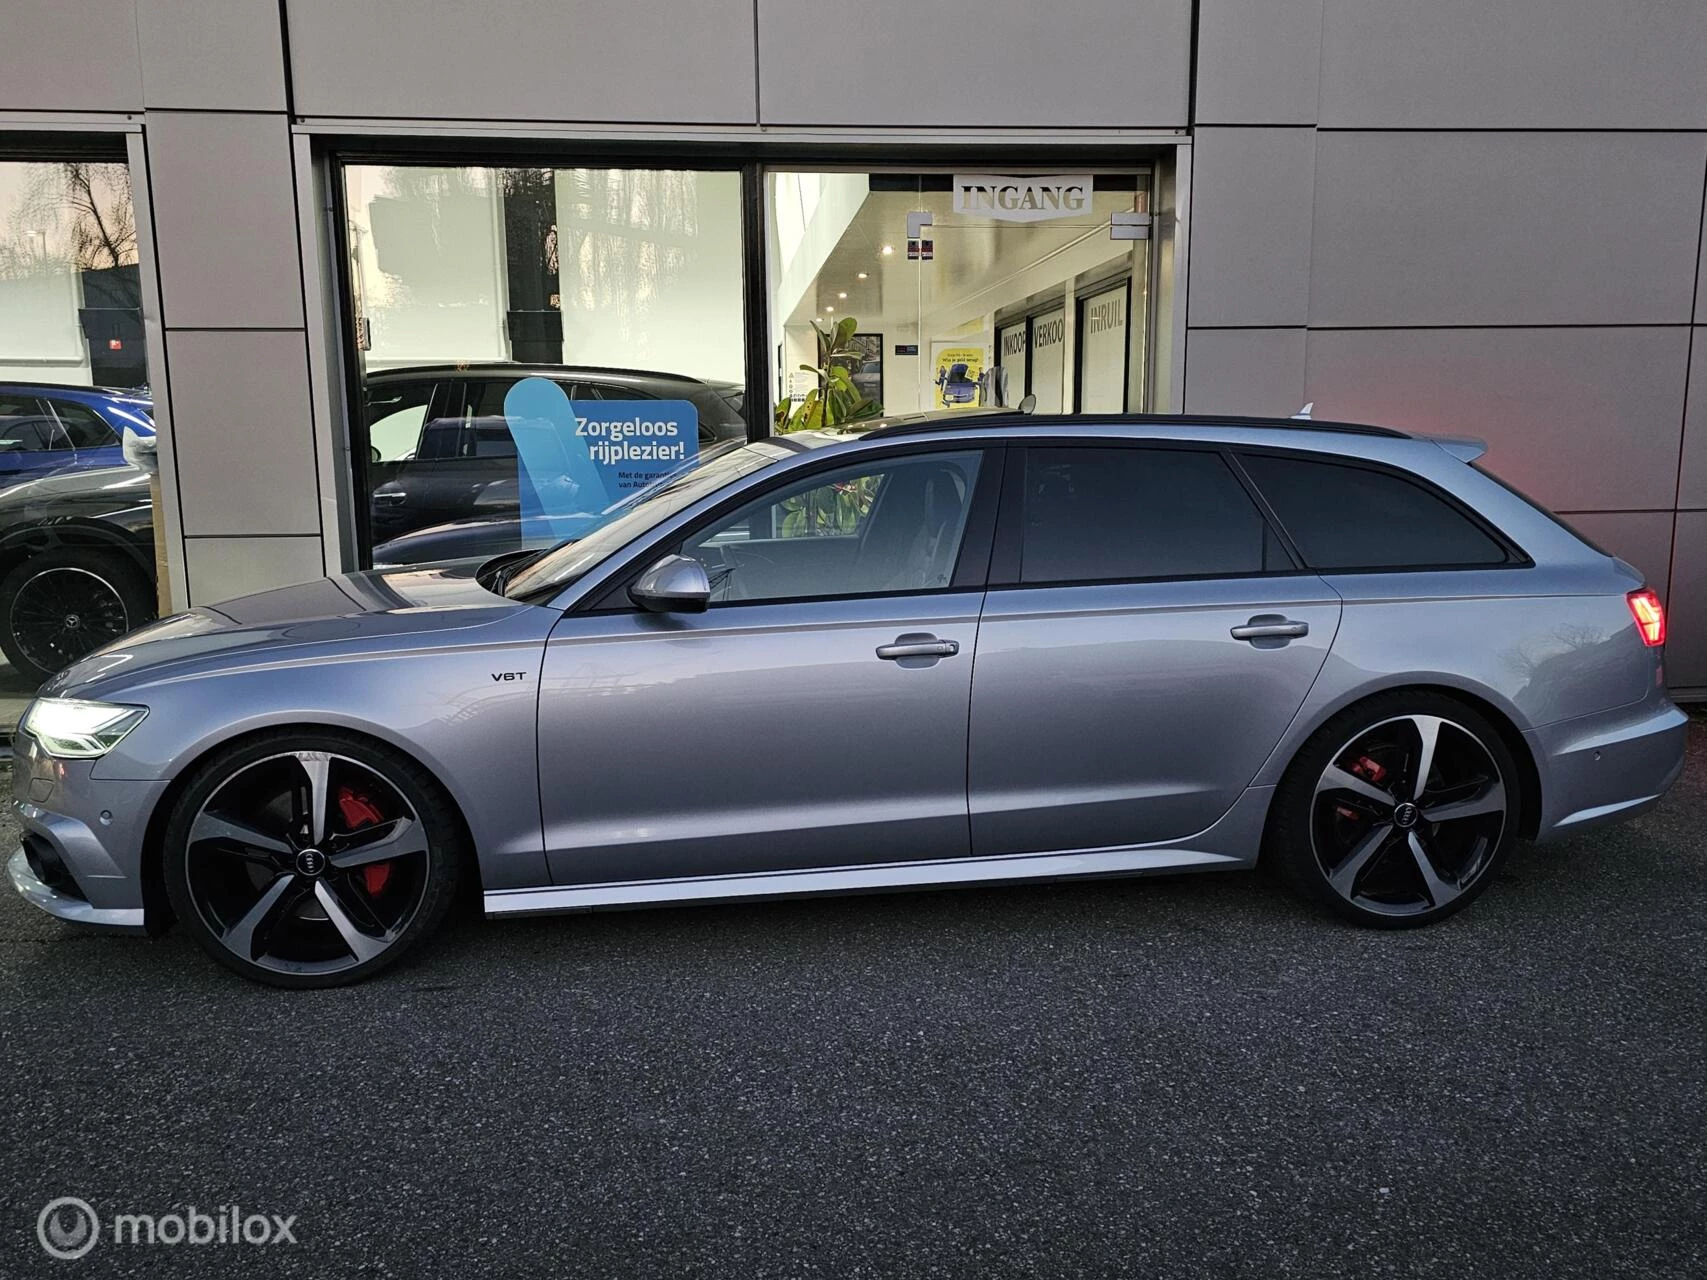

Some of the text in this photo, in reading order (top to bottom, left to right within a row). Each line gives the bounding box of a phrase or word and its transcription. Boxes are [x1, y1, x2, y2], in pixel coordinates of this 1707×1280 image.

[961, 185, 1085, 210] INGANG
[1090, 298, 1123, 335] INRUIL
[1004, 331, 1027, 357] INKOOP
[575, 417, 678, 441] Zorgeloos
[589, 441, 685, 465] rijplezier!
[618, 471, 632, 479] Met
[634, 471, 643, 479] de
[491, 672, 527, 682] V6T
